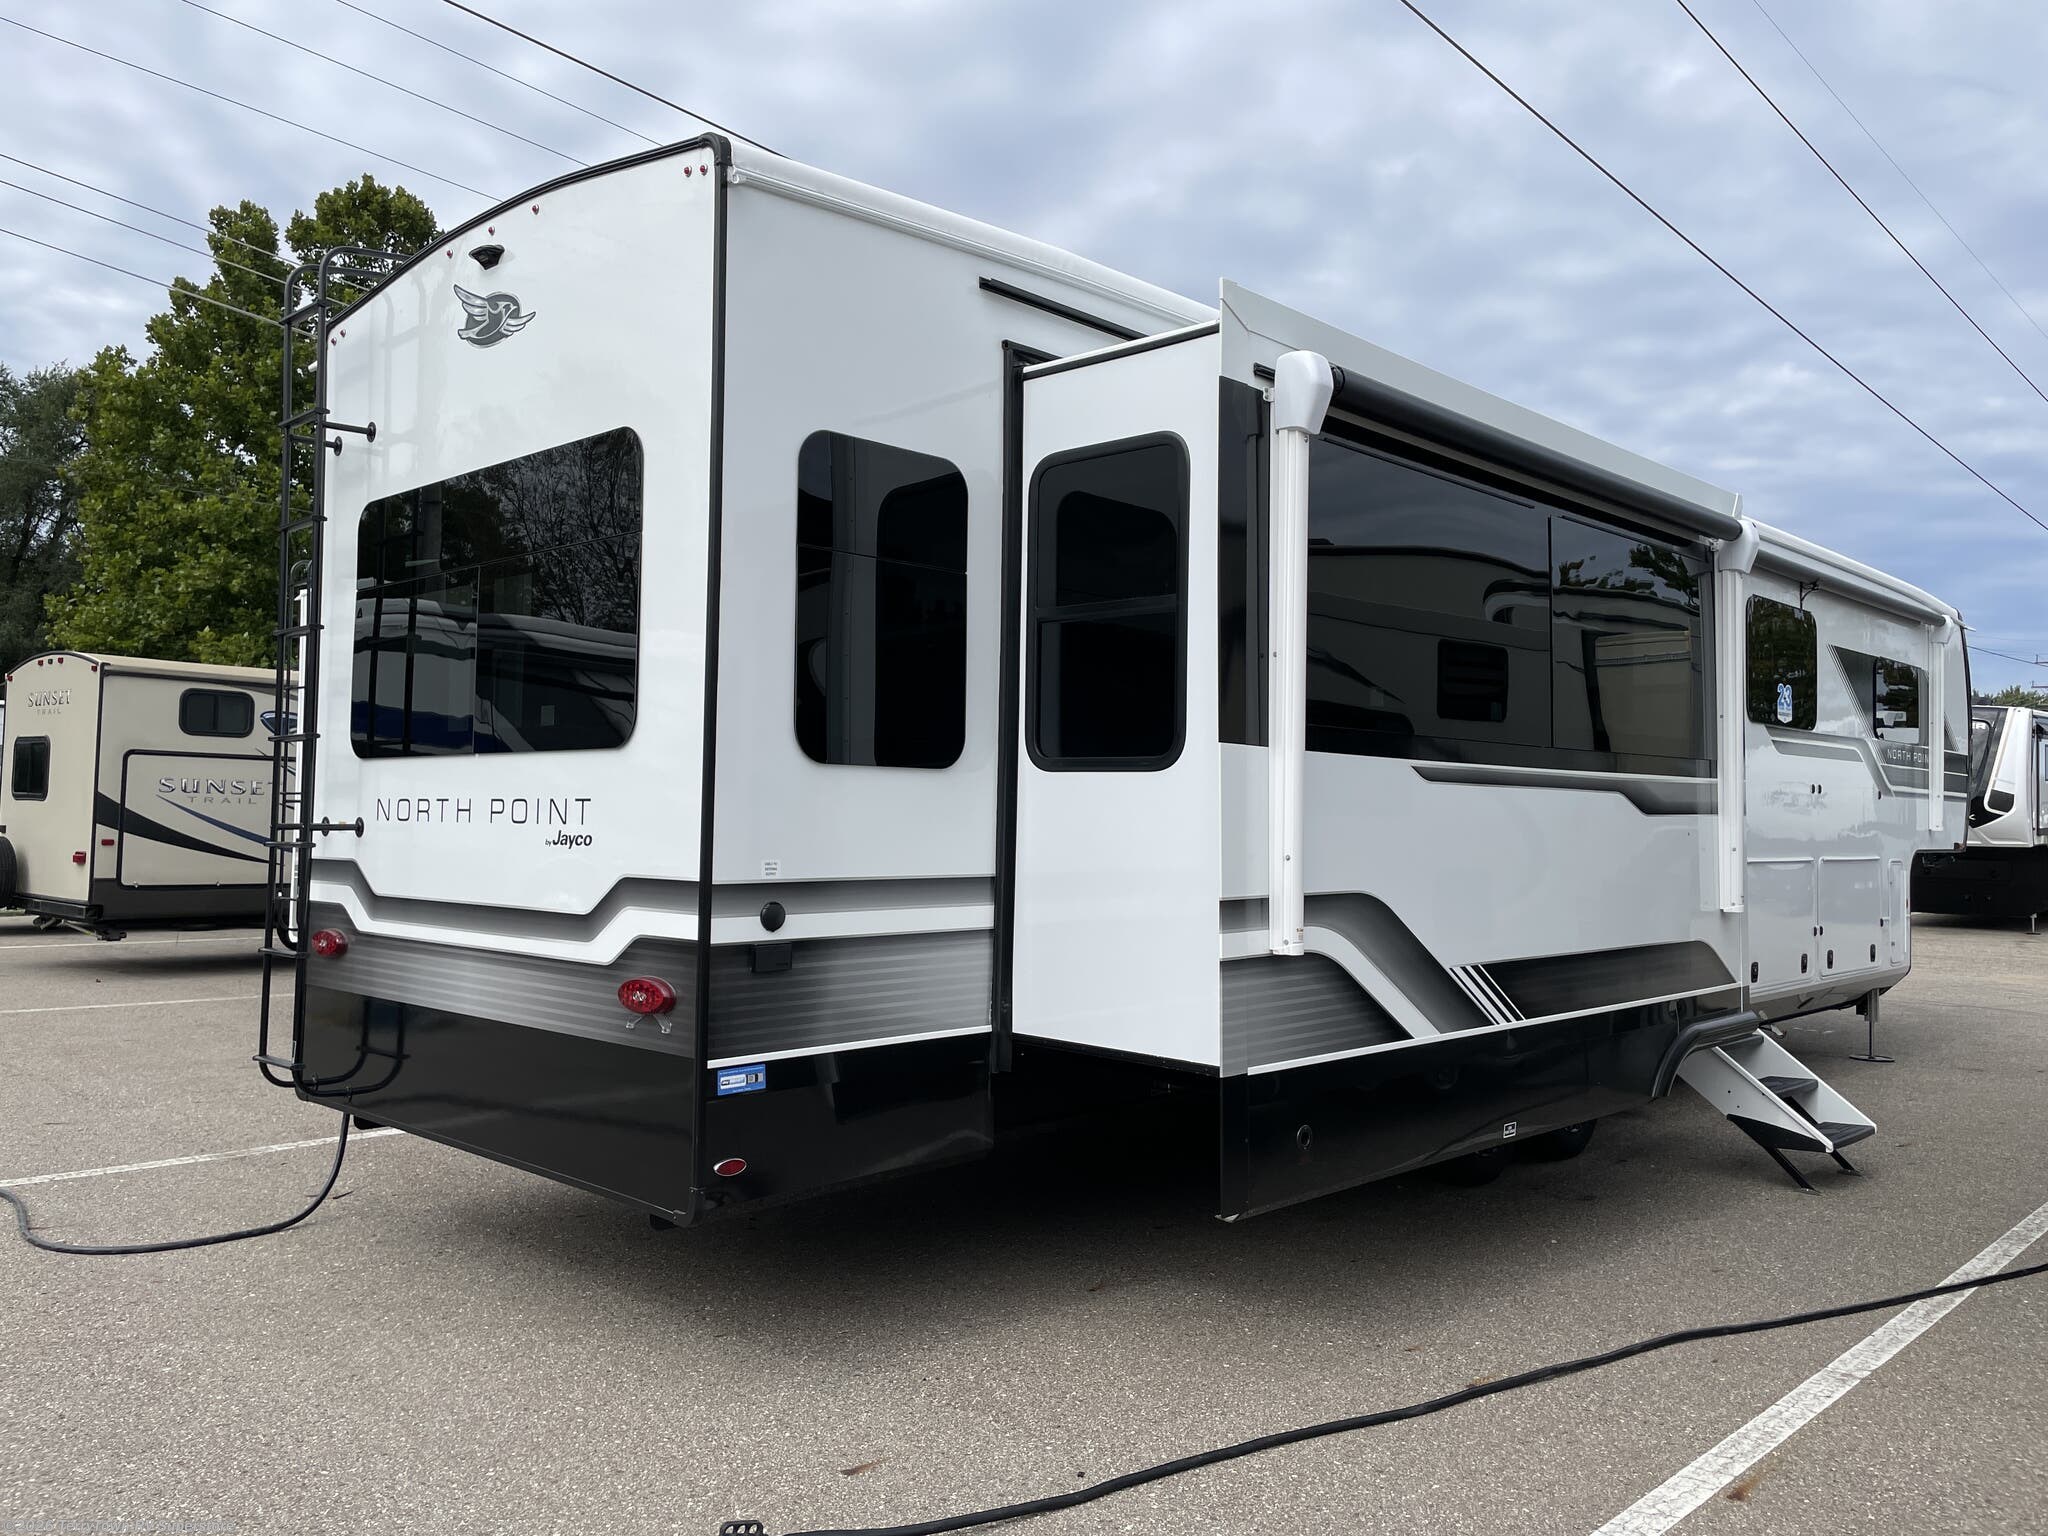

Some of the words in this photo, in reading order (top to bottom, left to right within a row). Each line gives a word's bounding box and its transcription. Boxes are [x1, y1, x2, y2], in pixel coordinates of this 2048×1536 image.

[28, 690, 71, 707] SUNSET
[1778, 684, 1792, 707] 23
[36, 708, 62, 716] TRAIL
[1887, 748, 1911, 761] NORTH
[1913, 752, 1929, 764] POIN
[158, 777, 273, 796] SUNSE
[186, 796, 257, 805] TRAIL
[376, 798, 472, 823] NORTH
[490, 798, 592, 825] POINT
[545, 839, 552, 847] by
[552, 829, 593, 849] Jayco
